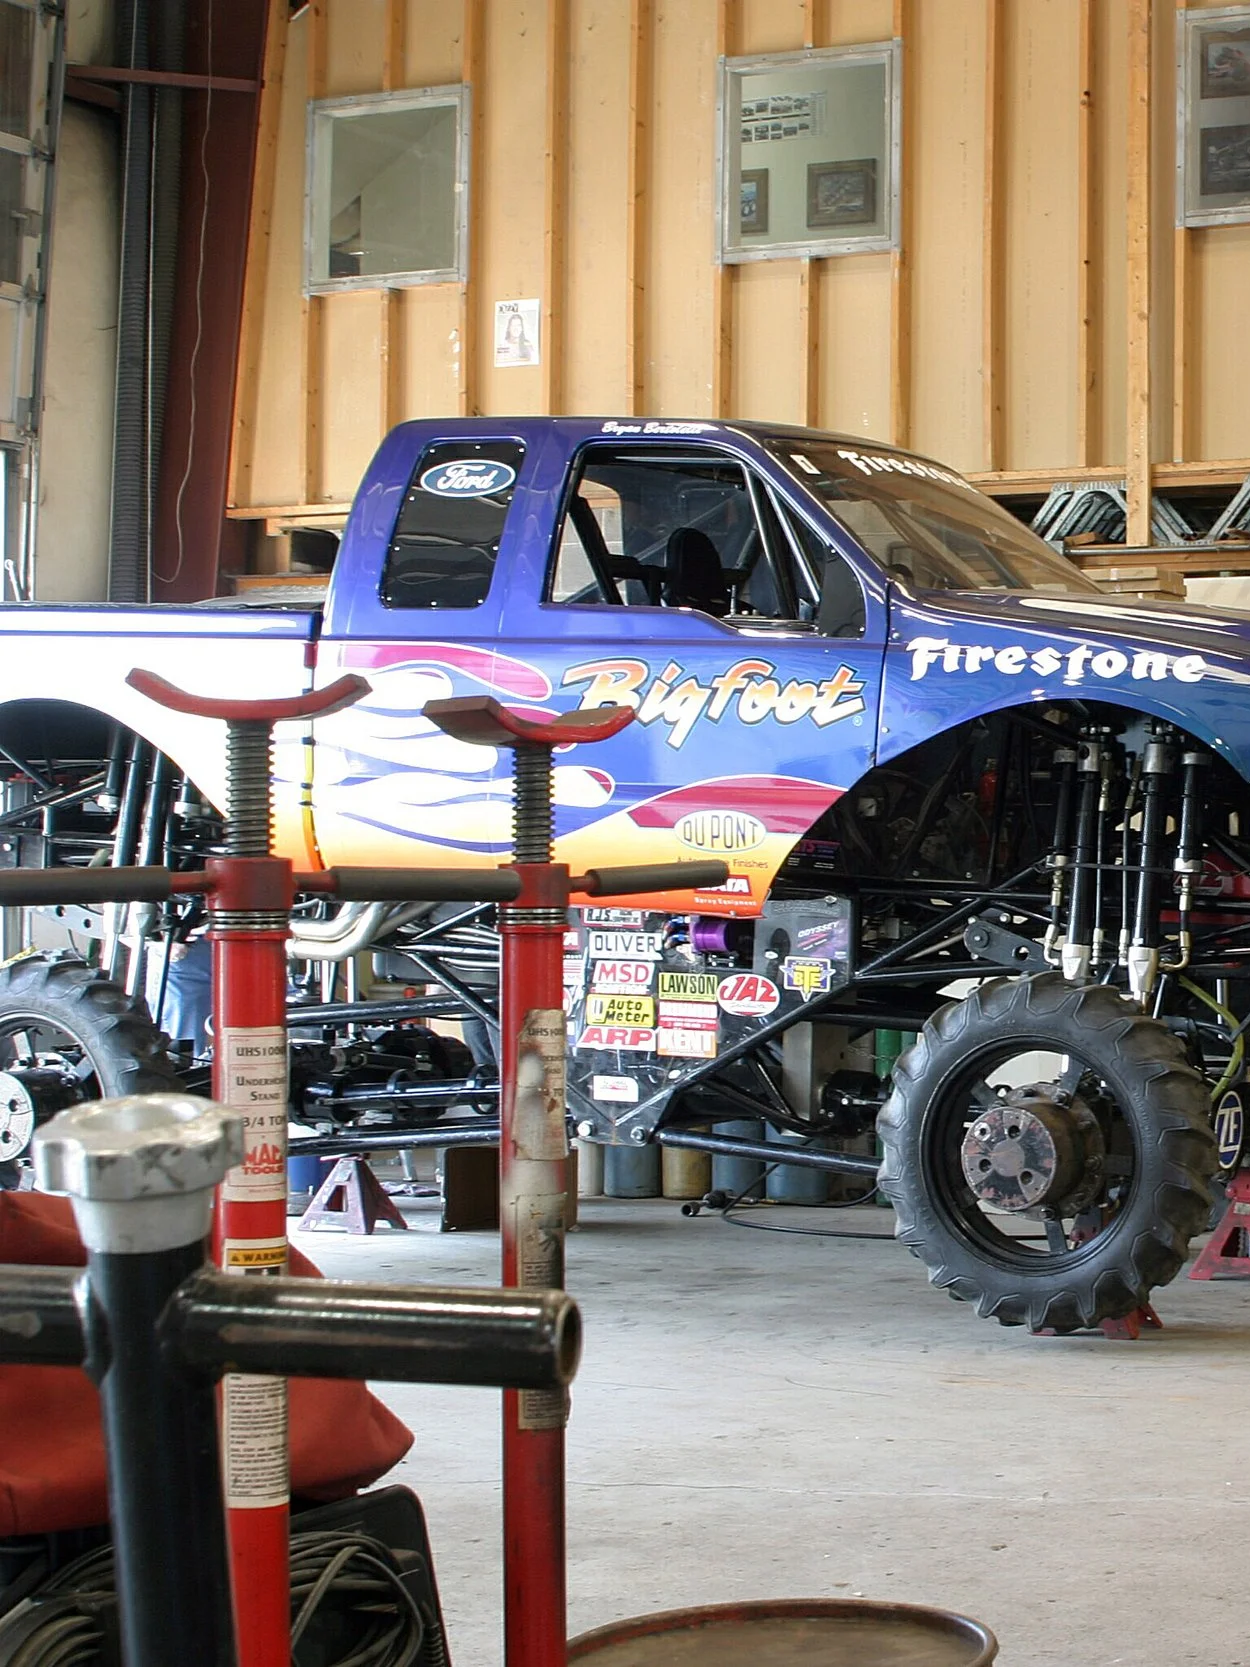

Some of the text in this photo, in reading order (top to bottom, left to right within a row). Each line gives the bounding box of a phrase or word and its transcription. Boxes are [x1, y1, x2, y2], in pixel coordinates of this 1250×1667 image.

[437, 464, 498, 490] Ford
[837, 450, 979, 494] Firestone
[906, 637, 1207, 684] Firestone
[560, 657, 868, 750] Bigfoot
[733, 859, 768, 869] Finishes
[694, 896, 757, 907] Spray Equipment
[798, 921, 841, 938] ODYSSEY
[594, 934, 657, 953] OLIVER
[598, 963, 650, 984] MSD
[661, 974, 715, 995] LAWSON
[720, 976, 777, 1003] JAZ
[607, 999, 643, 1012] Auto
[604, 1011, 650, 1023] Meter
[582, 1027, 653, 1046] ARP
[1218, 1107, 1242, 1153] ZF
[243, 1143, 283, 1165] MAC
